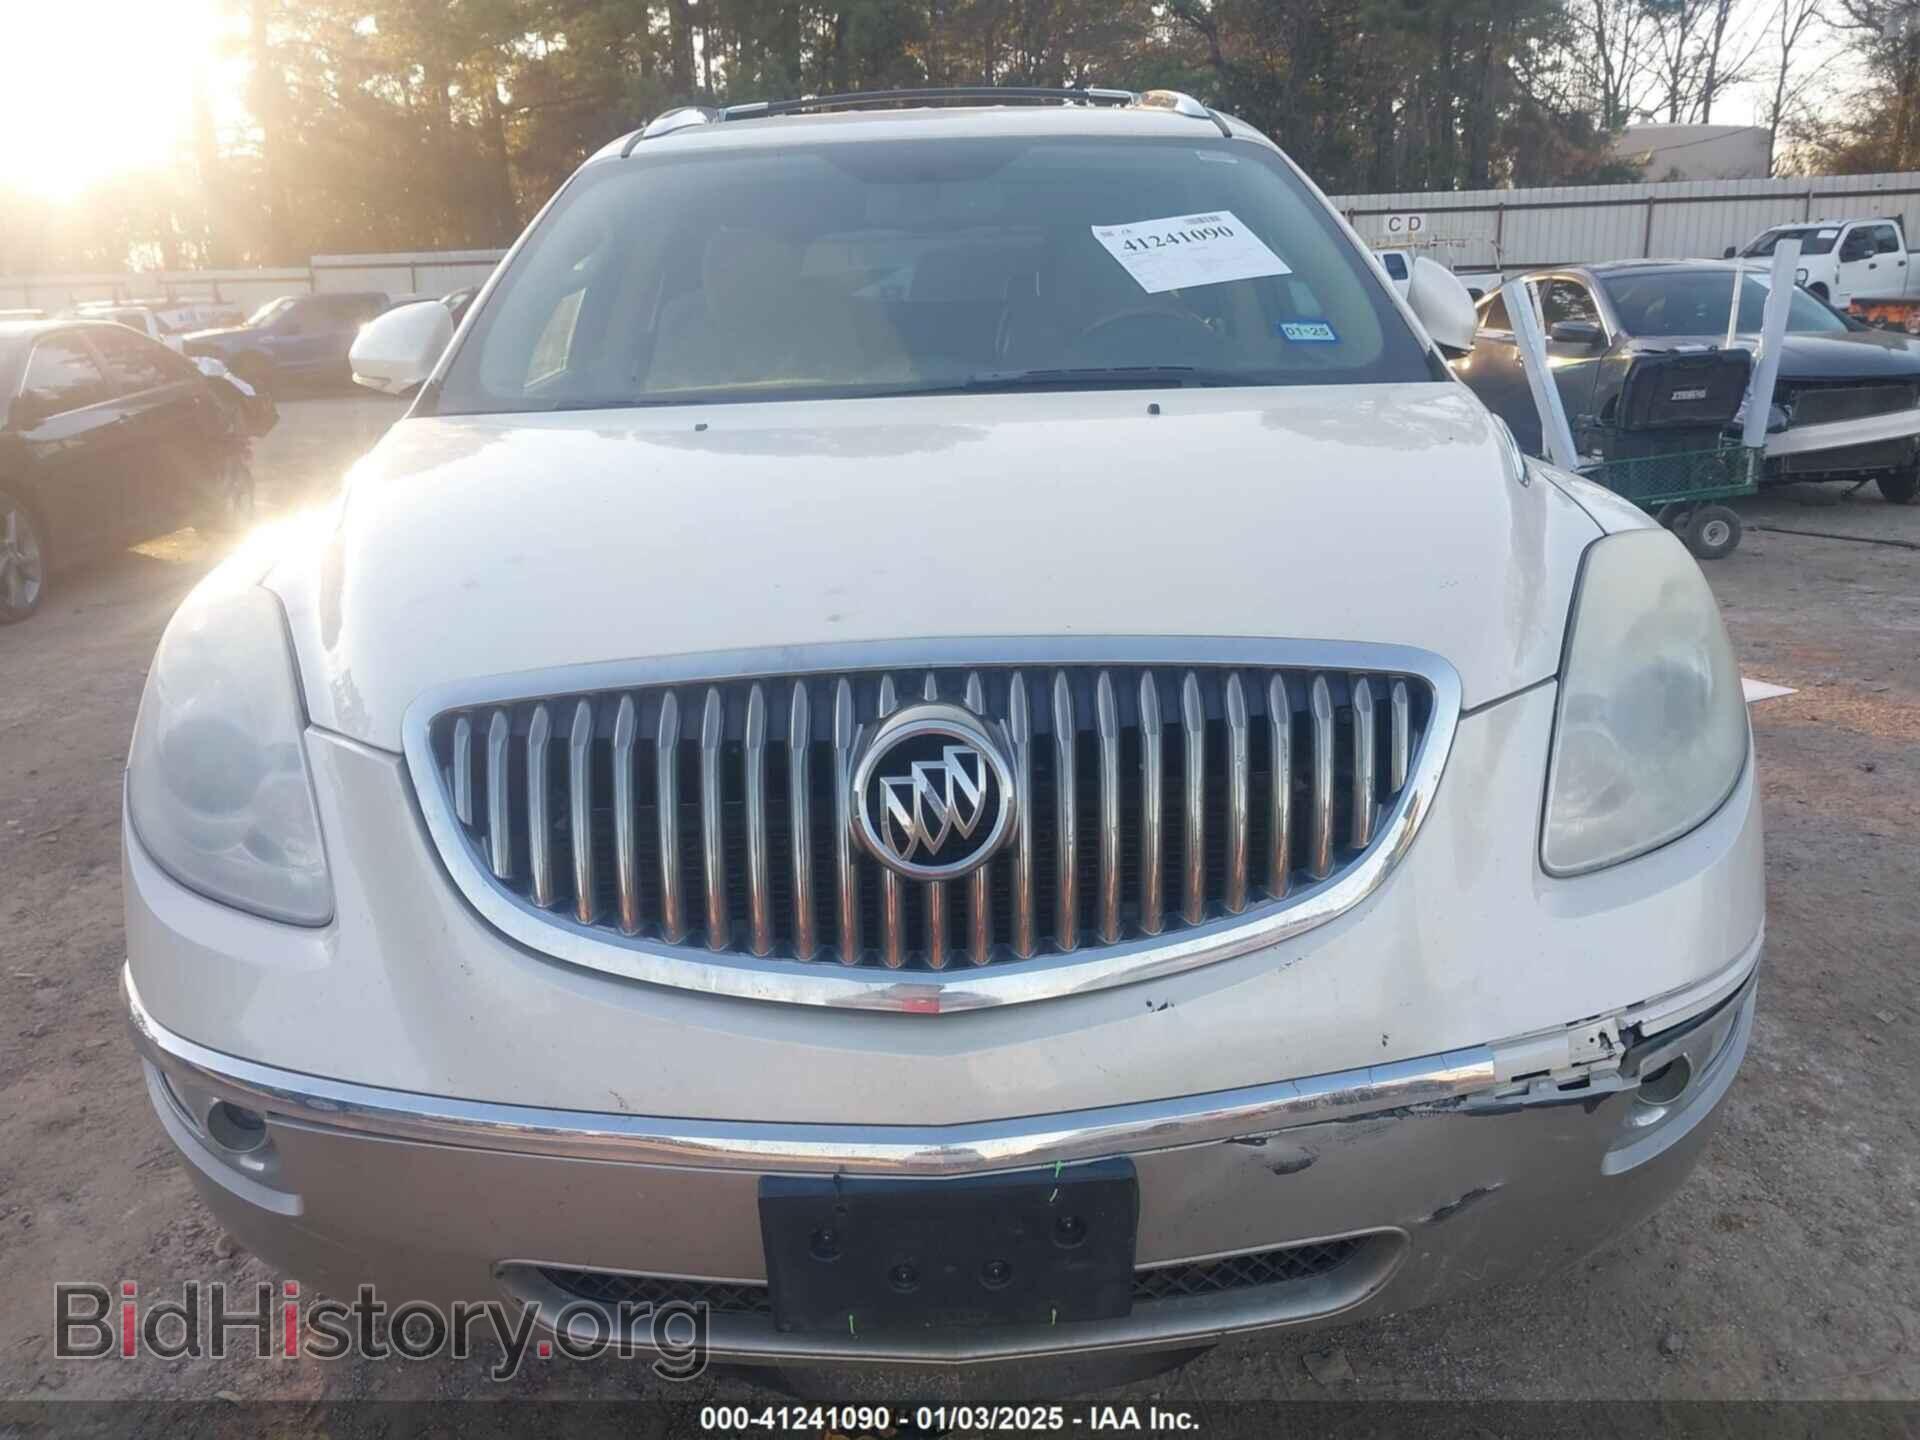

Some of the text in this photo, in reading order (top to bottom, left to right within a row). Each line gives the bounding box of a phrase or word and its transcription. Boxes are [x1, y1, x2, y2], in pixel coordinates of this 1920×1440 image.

[1388, 216, 1422, 232] C D
[1123, 225, 1235, 251] 41241090
